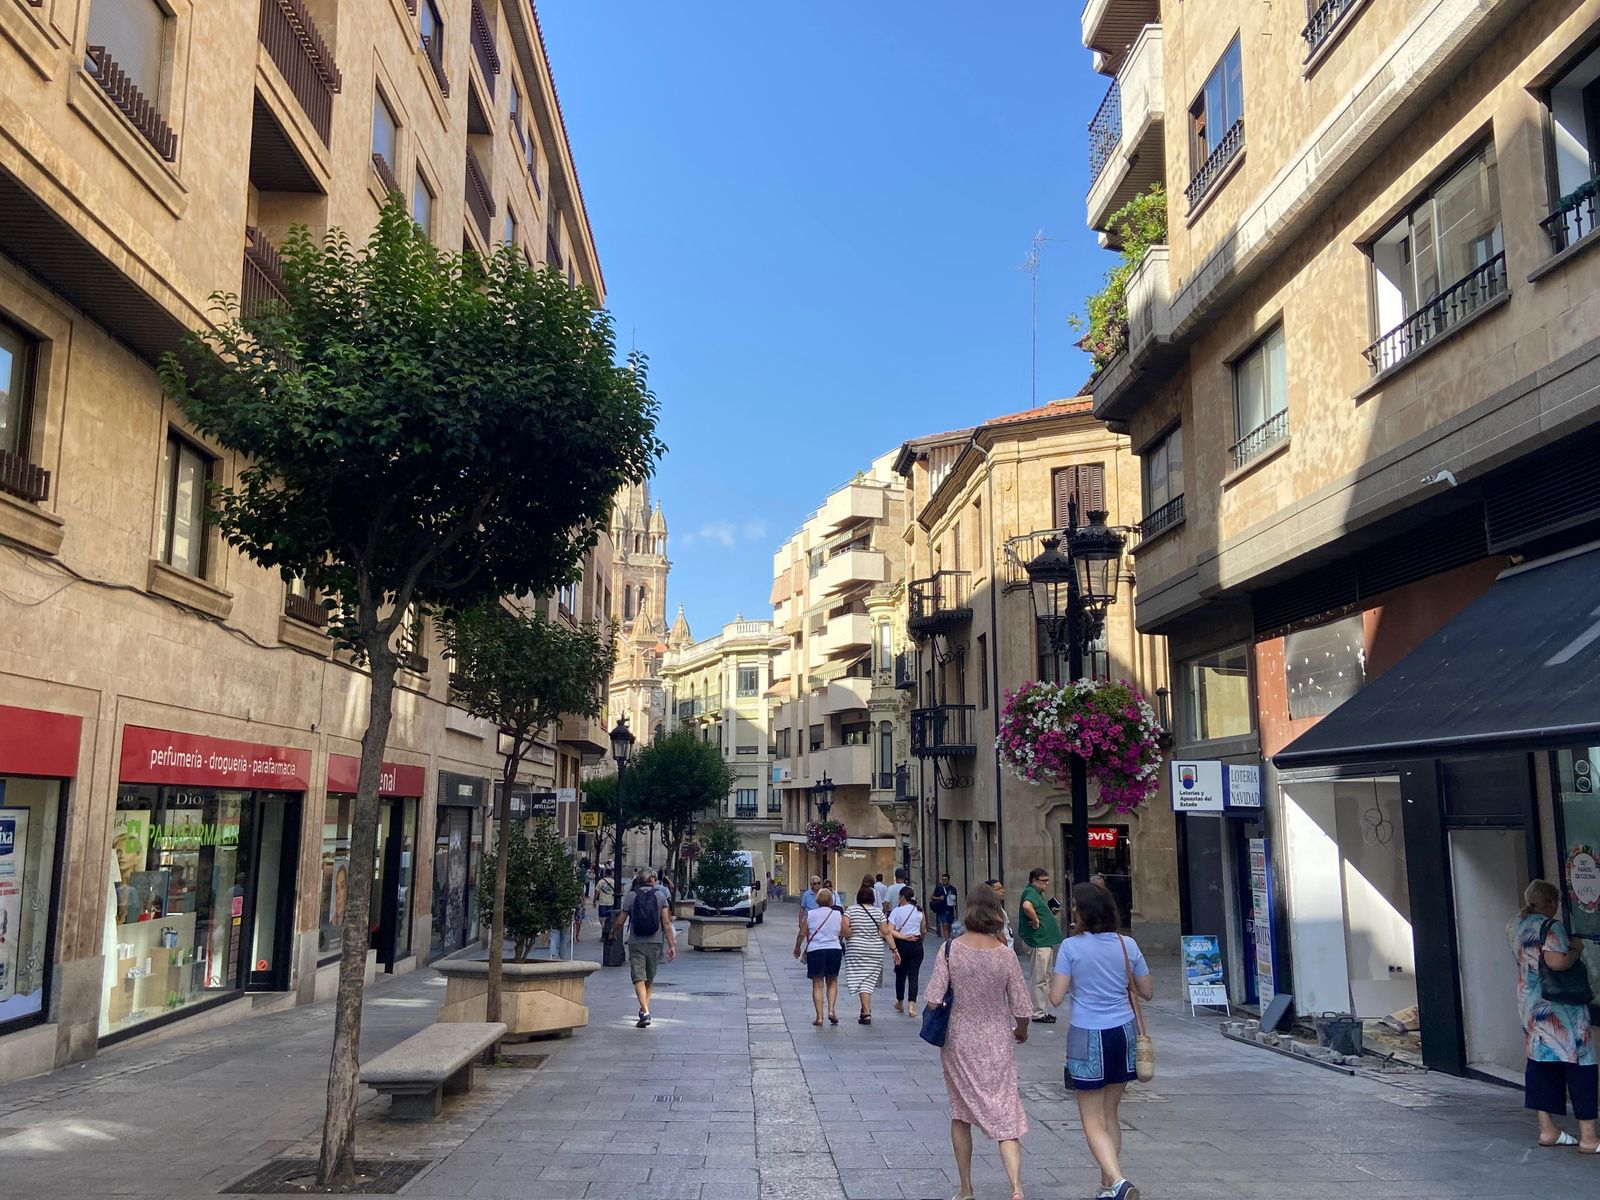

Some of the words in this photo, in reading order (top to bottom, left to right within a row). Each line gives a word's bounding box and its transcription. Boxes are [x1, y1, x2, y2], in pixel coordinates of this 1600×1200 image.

[150, 746, 202, 769] perfumería
[210, 752, 247, 774] droguería
[253, 757, 296, 776] parafarmacia
[379, 768, 396, 791] enal
[1231, 767, 1258, 783] LOTERÍA
[176, 793, 204, 805] Dio
[1231, 792, 1260, 805] NAVIDAD
[0, 827, 13, 844] ixa
[149, 823, 239, 848] PARAFARMACIA
[1088, 832, 1114, 840] evi's
[1192, 988, 1216, 997] AGUA
